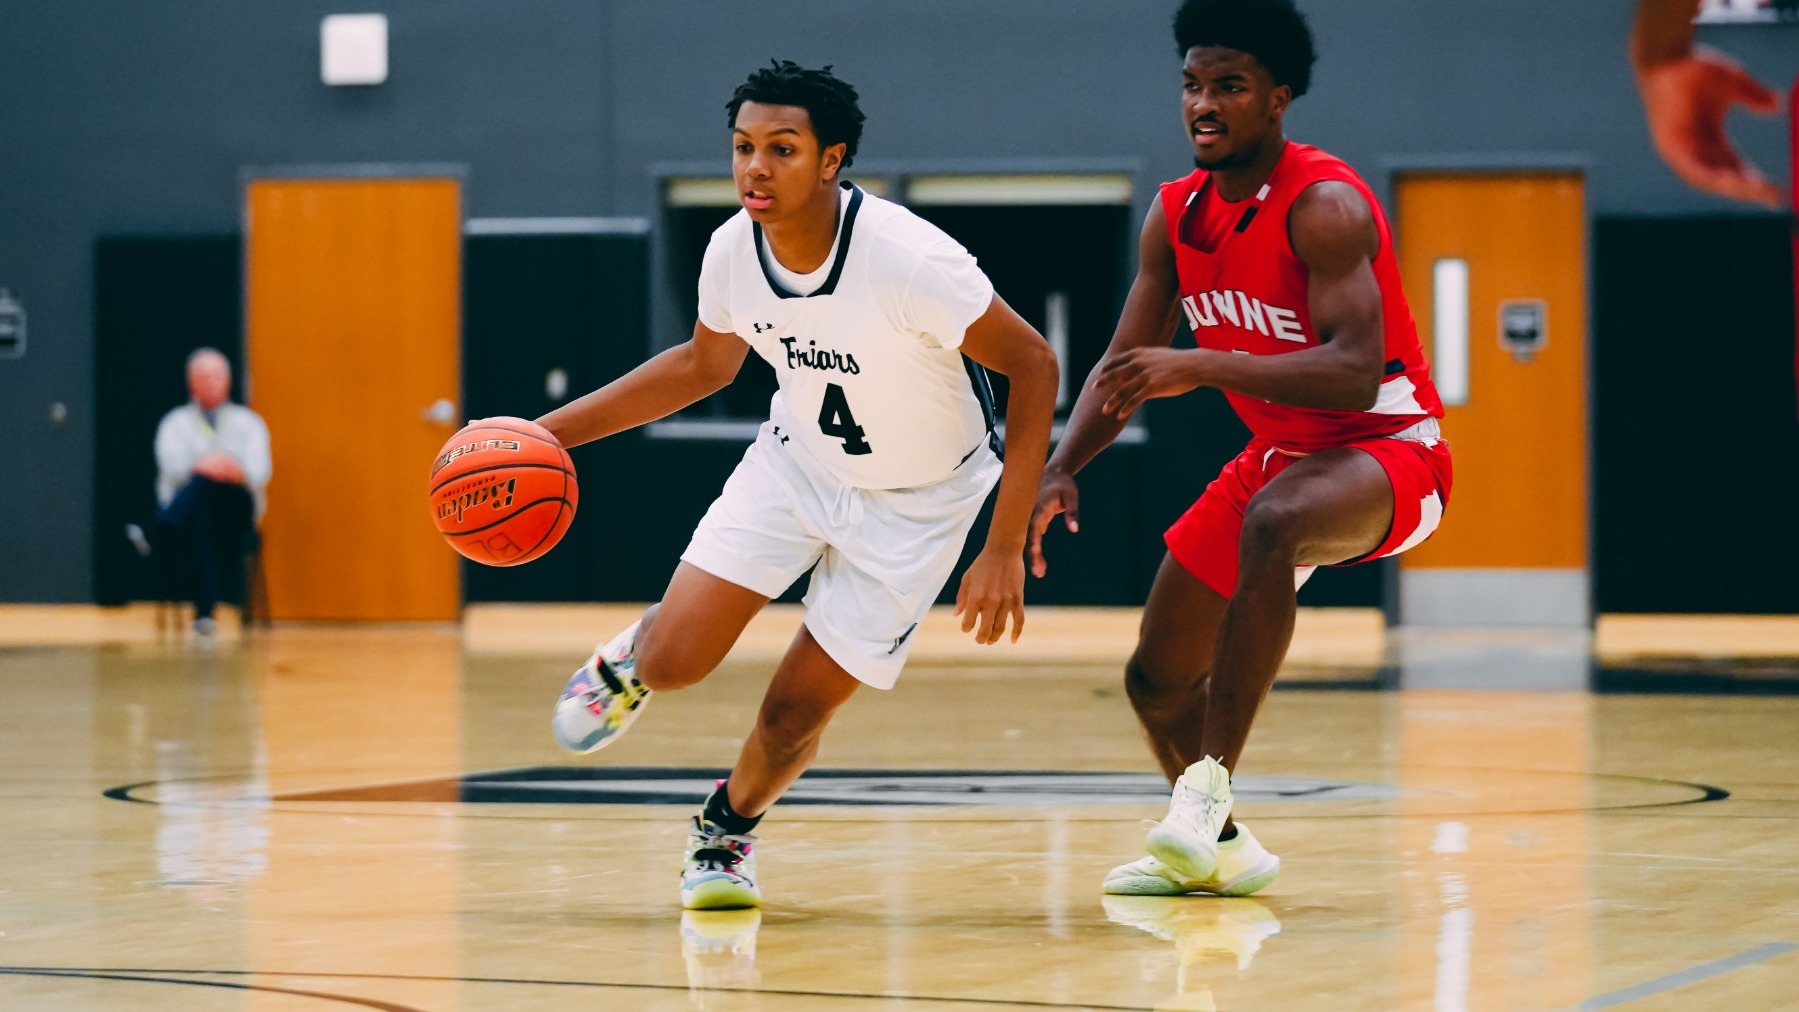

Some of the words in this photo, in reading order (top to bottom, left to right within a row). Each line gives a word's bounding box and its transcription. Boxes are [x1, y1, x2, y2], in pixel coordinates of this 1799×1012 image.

[779, 336, 861, 375] Friars
[818, 382, 873, 455] 4
[438, 478, 517, 523] Baden
